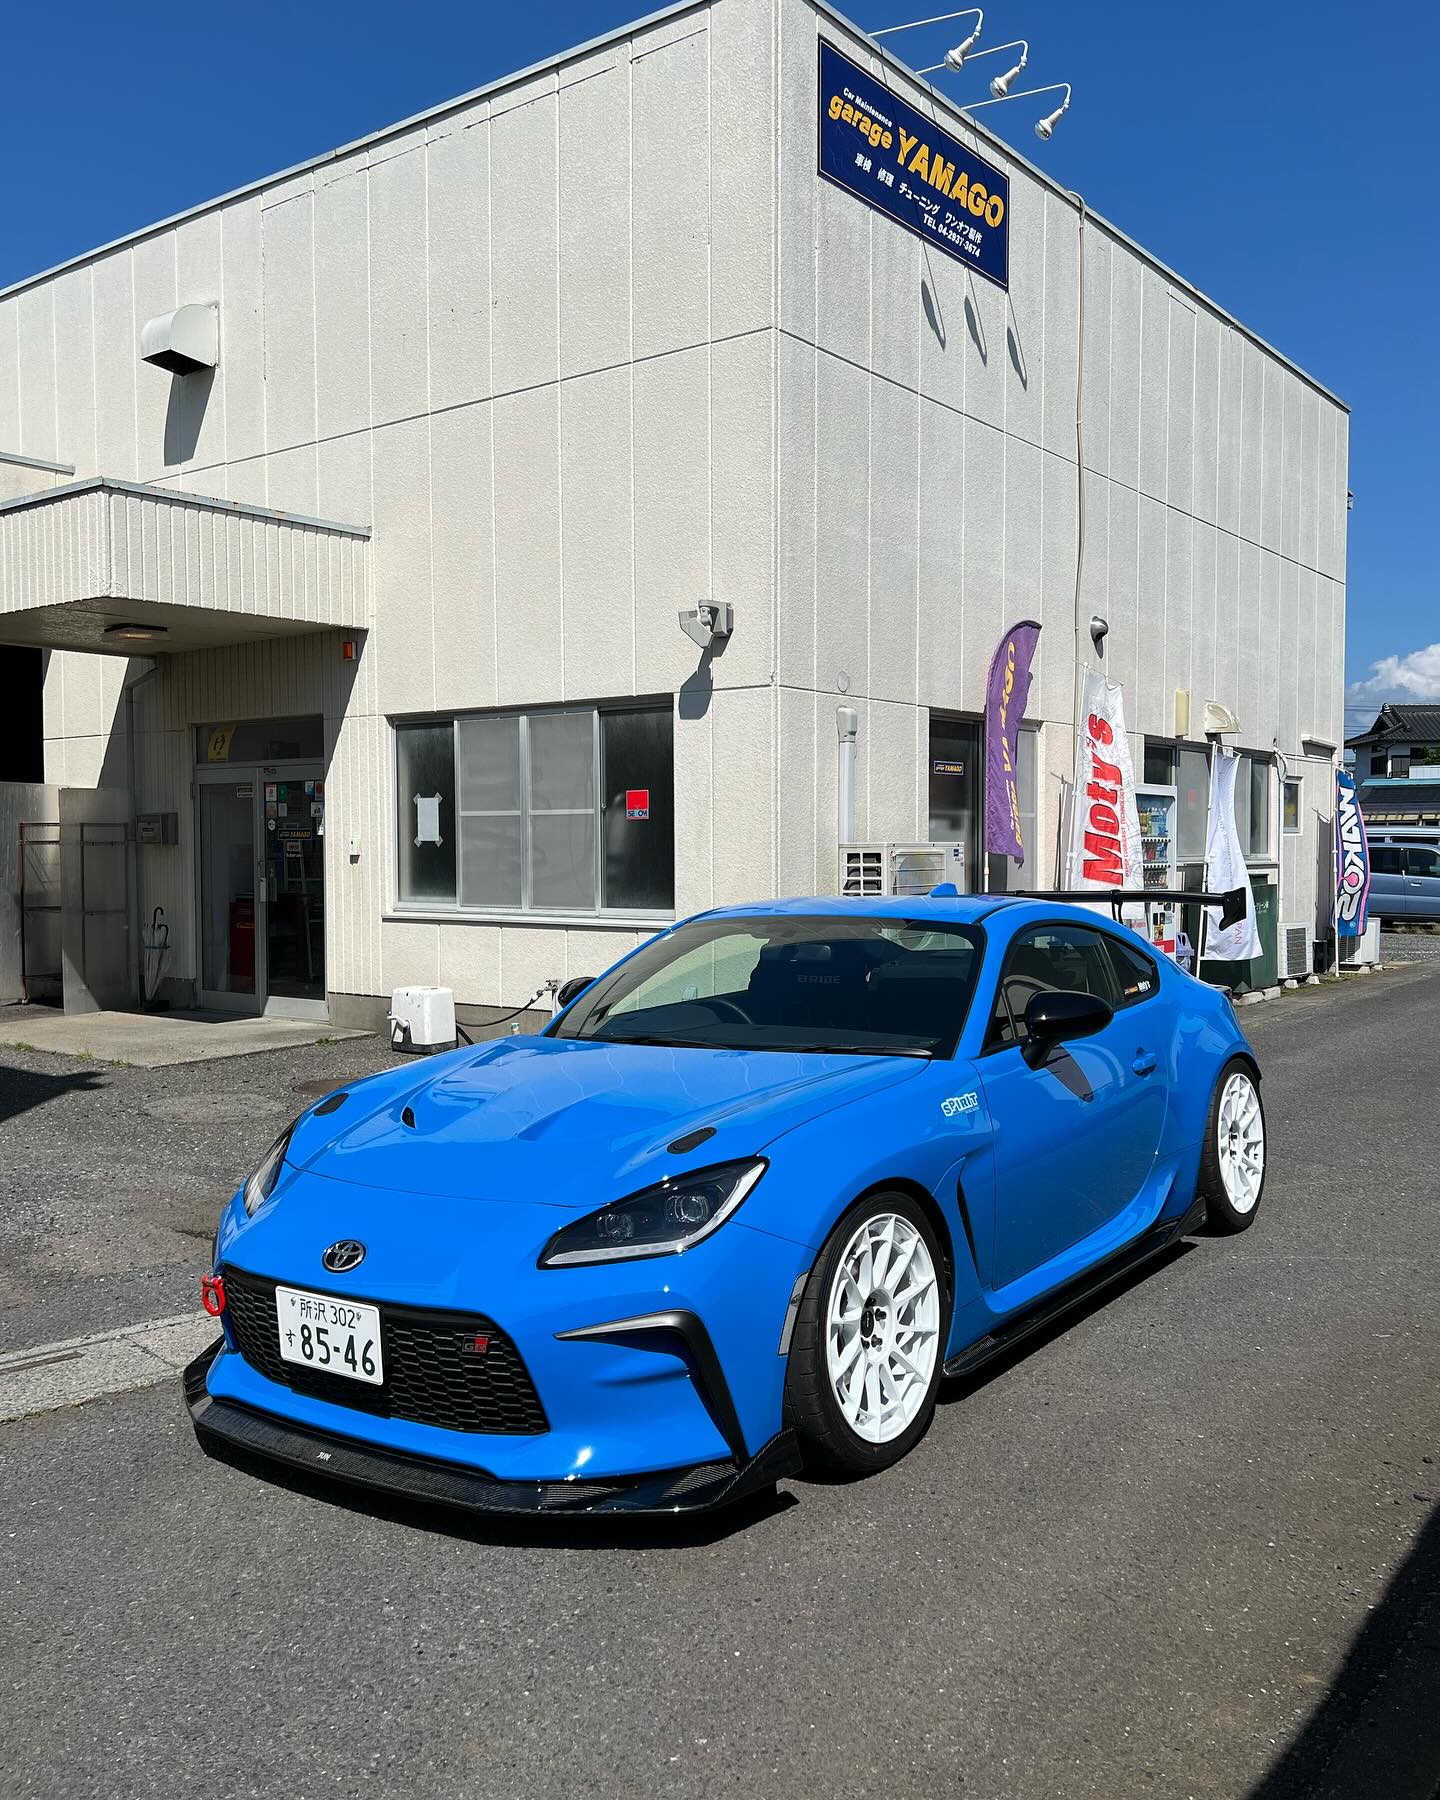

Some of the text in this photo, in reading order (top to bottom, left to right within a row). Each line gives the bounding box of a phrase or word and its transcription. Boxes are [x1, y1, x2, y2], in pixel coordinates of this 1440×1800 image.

[843, 87, 893, 127] Car Maintenance
[828, 95, 1004, 228] garage YAMAGO
[854, 152, 983, 244] 車検 修理 チューニング ワンオフ製作
[923, 213, 937, 230] TEL
[1084, 713, 1123, 887] Moty's
[940, 1091, 979, 1117] SPIRIT
[299, 1298, 356, 1329] 所沢 302
[285, 1323, 375, 1376] す 85-46
